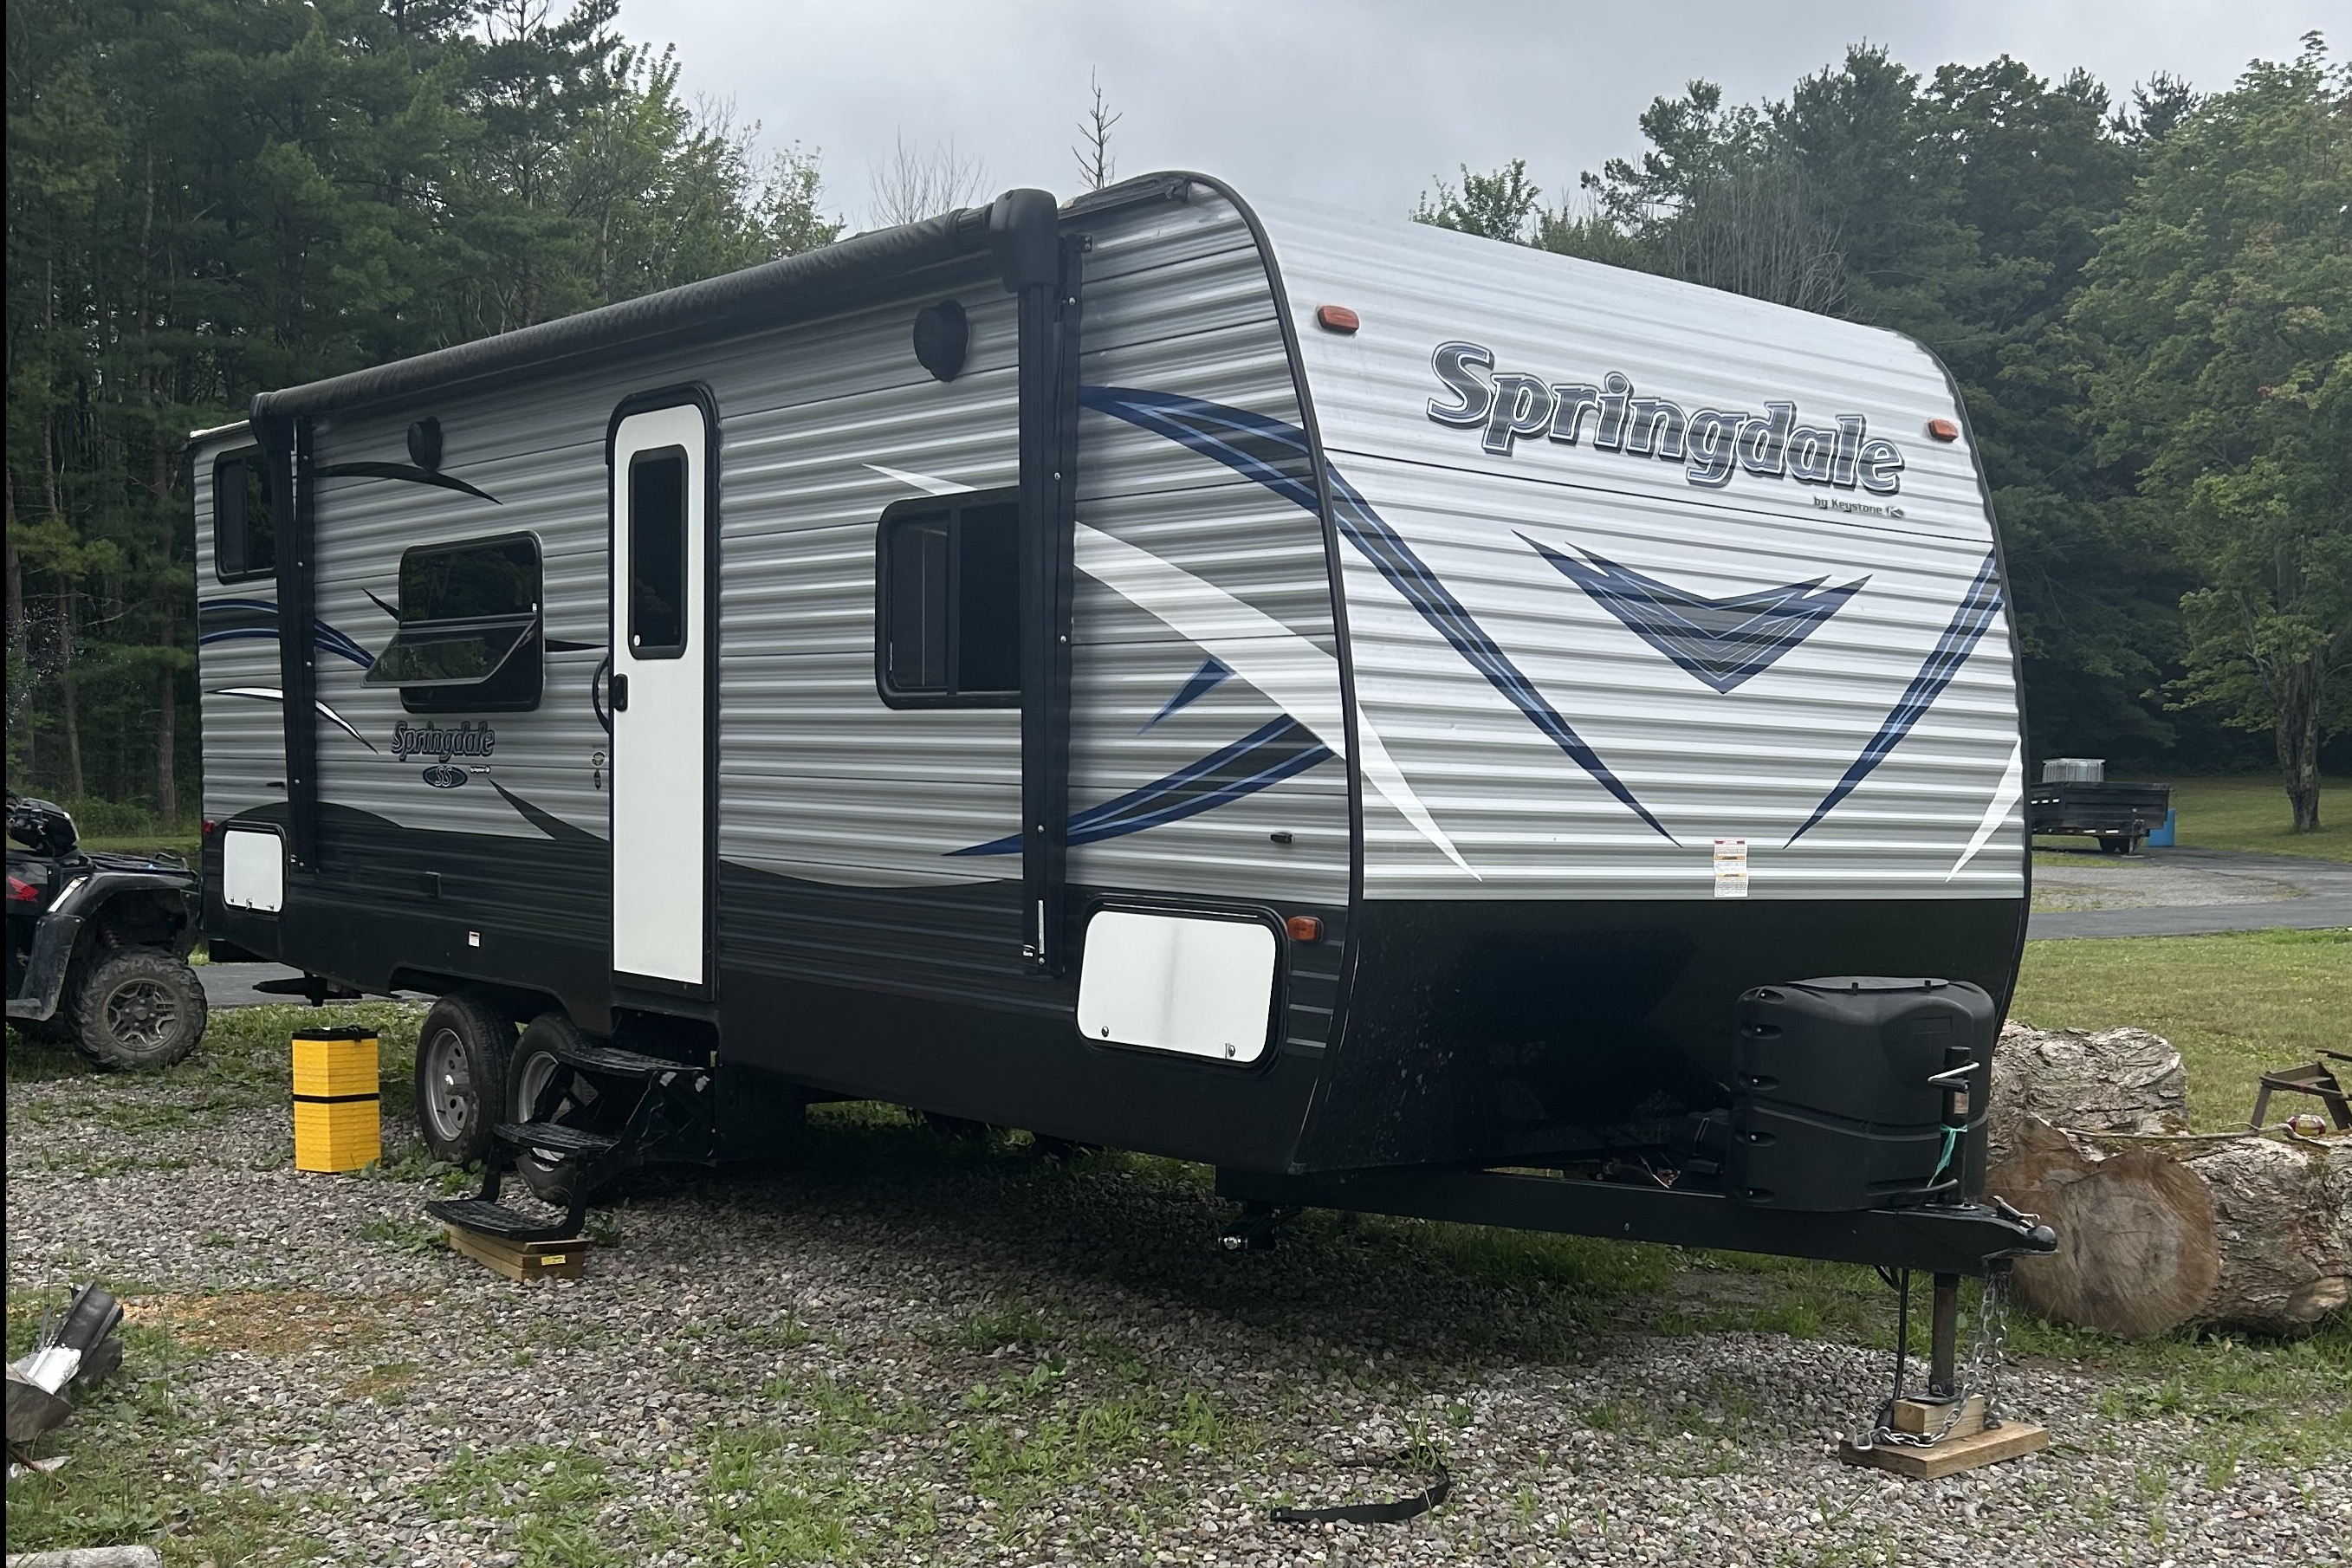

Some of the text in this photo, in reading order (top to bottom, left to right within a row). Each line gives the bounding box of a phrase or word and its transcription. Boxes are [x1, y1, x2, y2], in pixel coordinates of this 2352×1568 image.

[1428, 340, 1904, 495] Springdale
[1813, 496, 1882, 515] by Keystone
[392, 720, 496, 763] Springdale
[434, 765, 453, 787] SS
